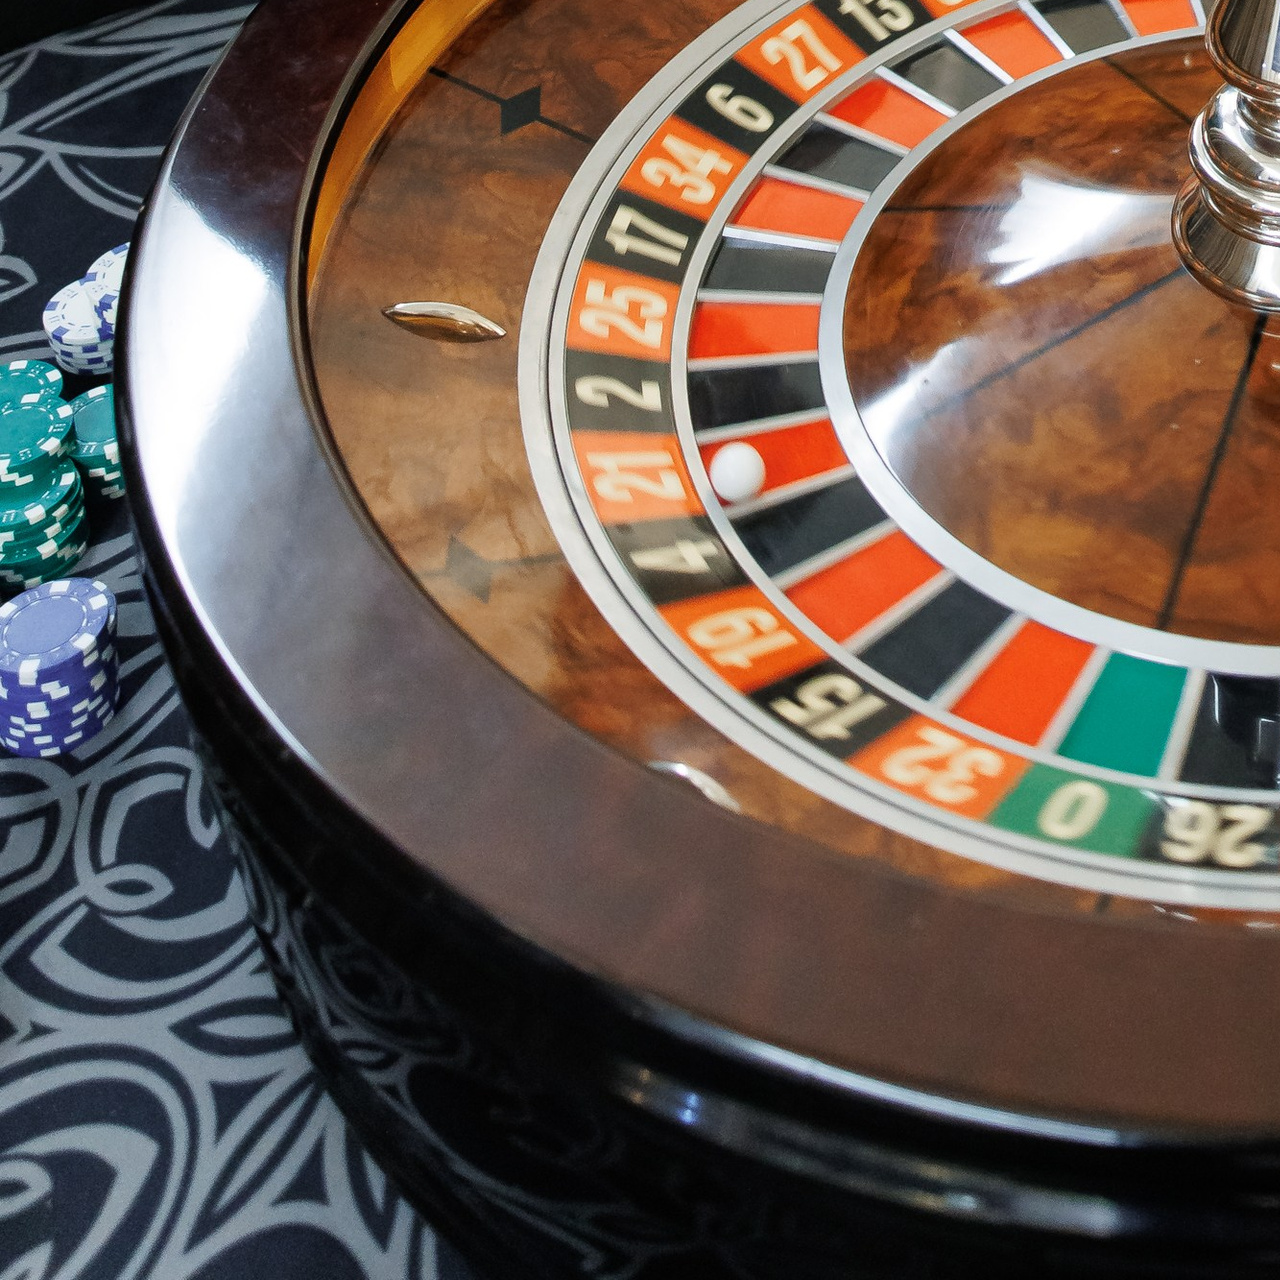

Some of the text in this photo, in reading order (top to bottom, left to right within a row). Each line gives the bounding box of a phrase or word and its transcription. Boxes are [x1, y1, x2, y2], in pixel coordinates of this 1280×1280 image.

[762, 20, 843, 91] 27
[706, 84, 774, 132] 6
[642, 135, 733, 204] 34
[605, 206, 689, 266] 17
[580, 280, 667, 347] 25
[576, 375, 660, 411] 2
[587, 450, 682, 504] 21
[634, 539, 717, 574] 4
[687, 608, 798, 668] 19
[775, 674, 887, 740] 15
[881, 727, 1003, 803] 32
[1038, 780, 1109, 839] 0
[1160, 802, 1272, 868] 26
